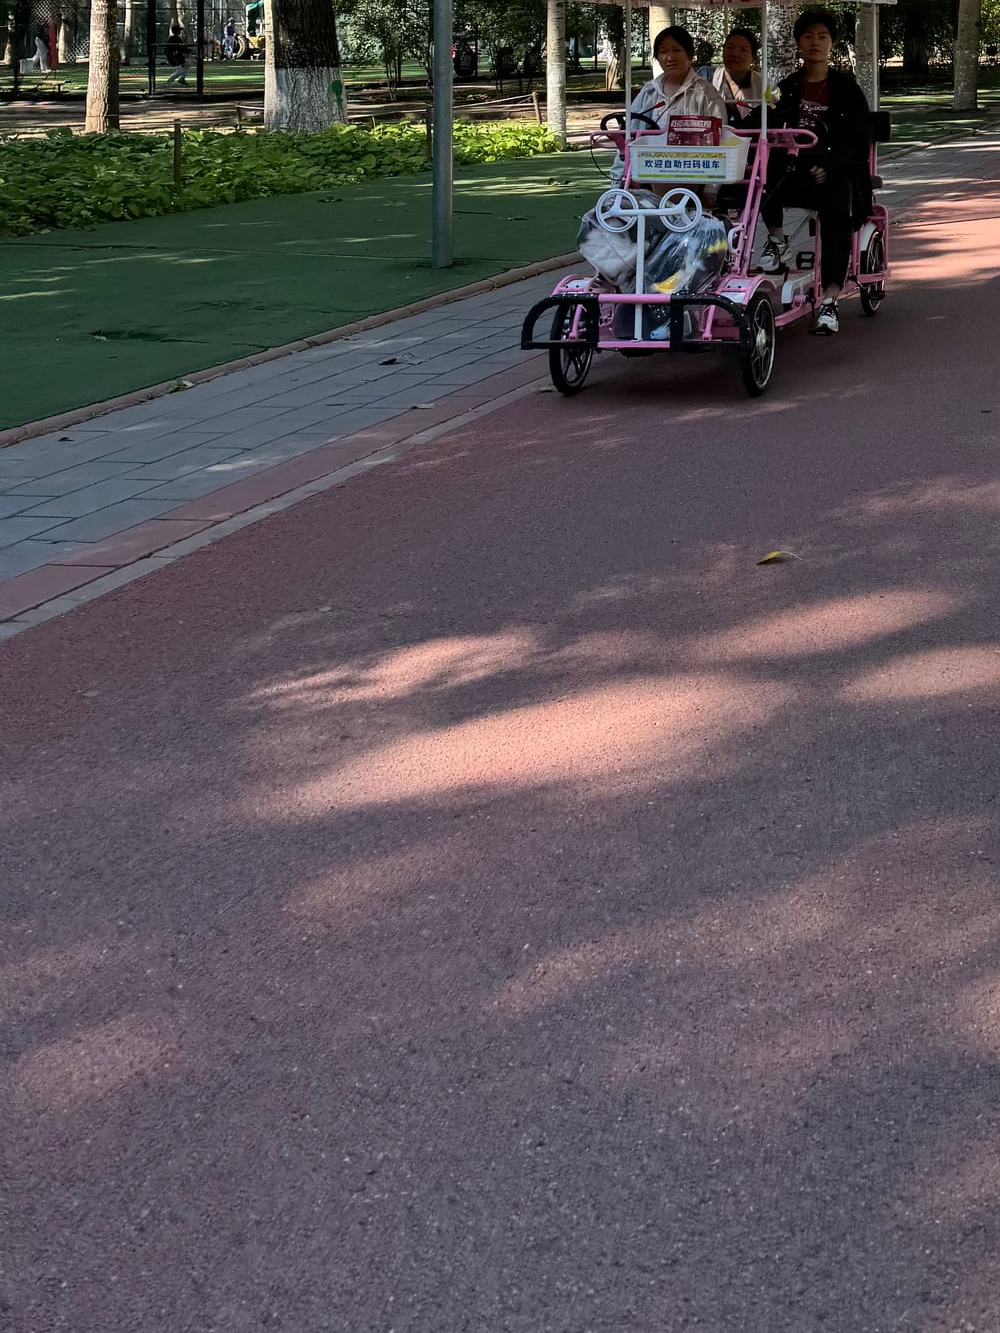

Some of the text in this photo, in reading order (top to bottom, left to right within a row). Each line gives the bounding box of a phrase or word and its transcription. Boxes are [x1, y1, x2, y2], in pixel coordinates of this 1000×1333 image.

[644, 159, 720, 169] 欢迎自助扫码租车
